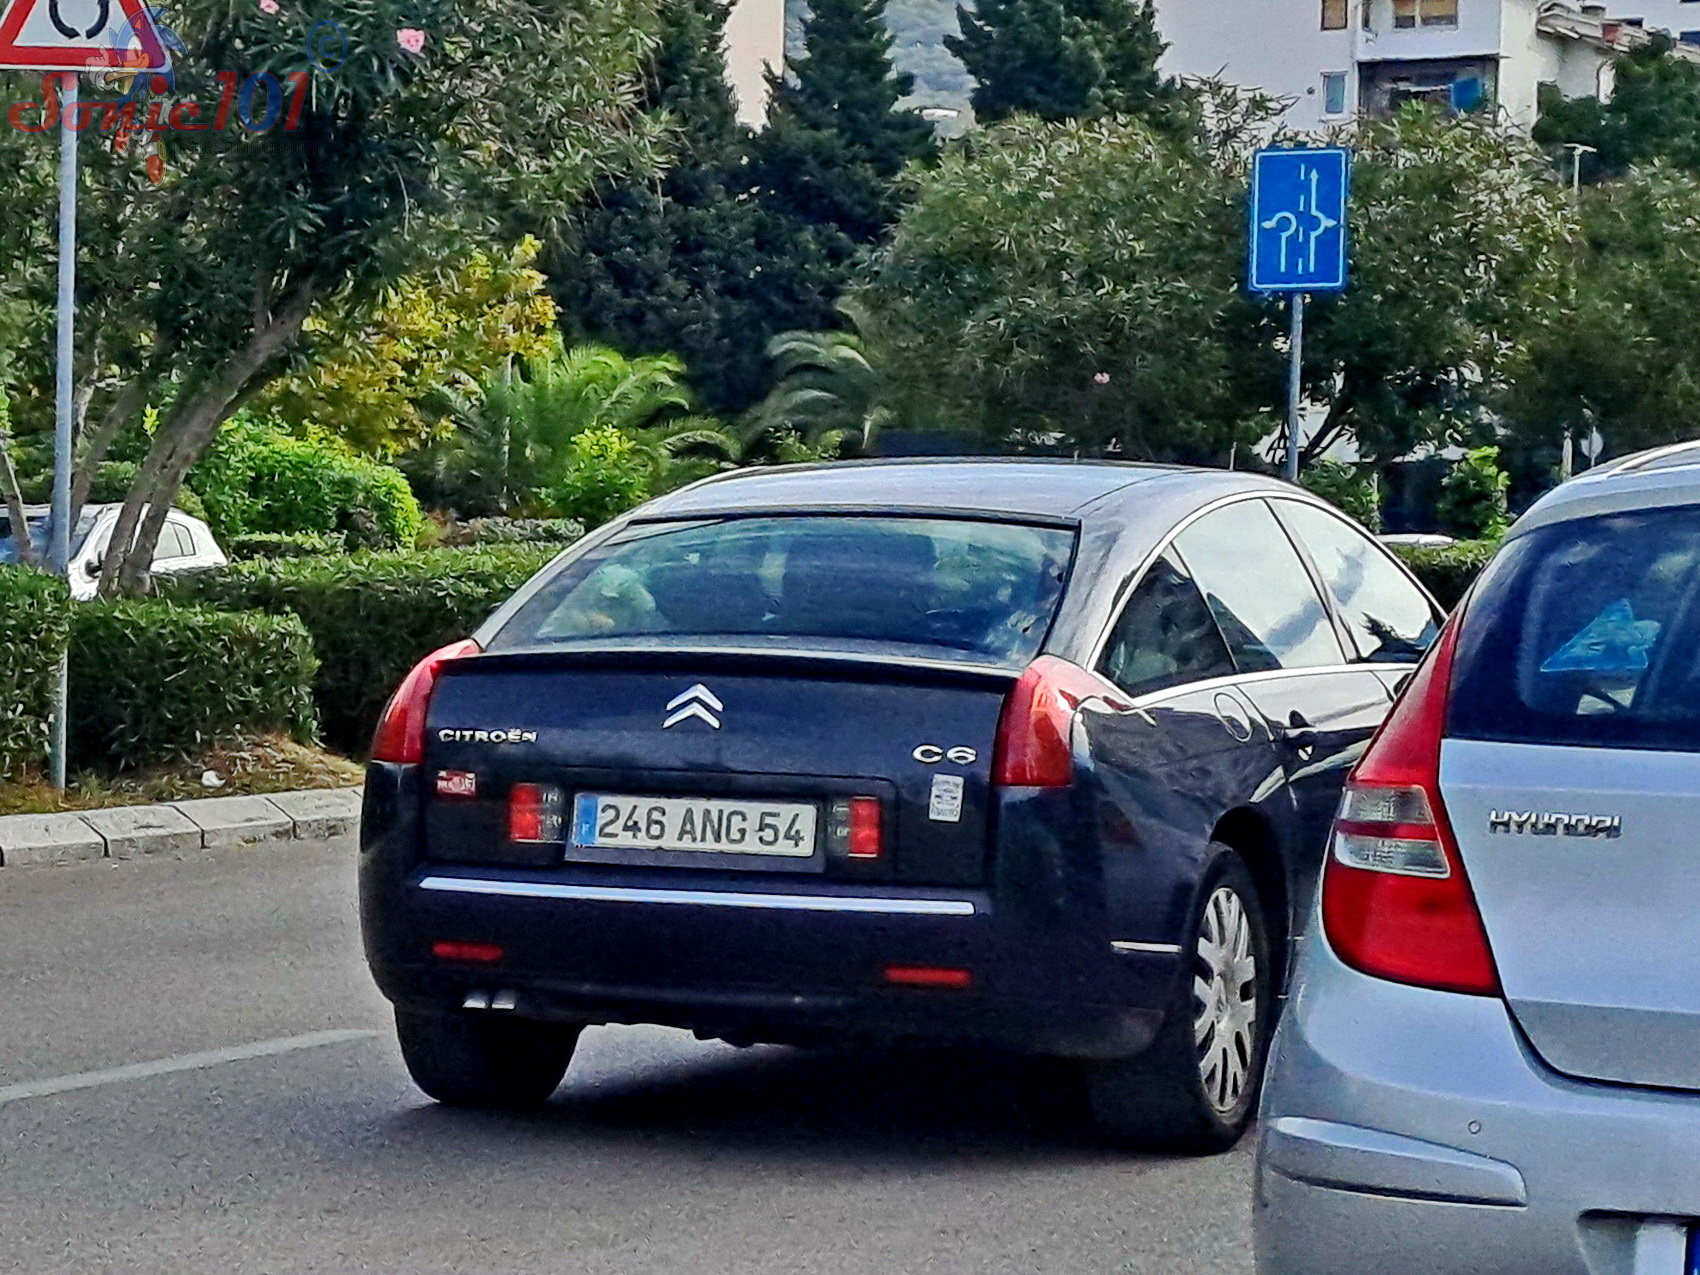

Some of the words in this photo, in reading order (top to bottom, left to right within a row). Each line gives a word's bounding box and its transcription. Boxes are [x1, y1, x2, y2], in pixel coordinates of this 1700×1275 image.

[438, 728, 538, 743] CITROËN
[912, 744, 977, 765] C6
[599, 803, 666, 840] 246
[676, 807, 748, 844] ANG
[755, 812, 805, 848] 54
[1489, 809, 1622, 838] HYUNDAI
